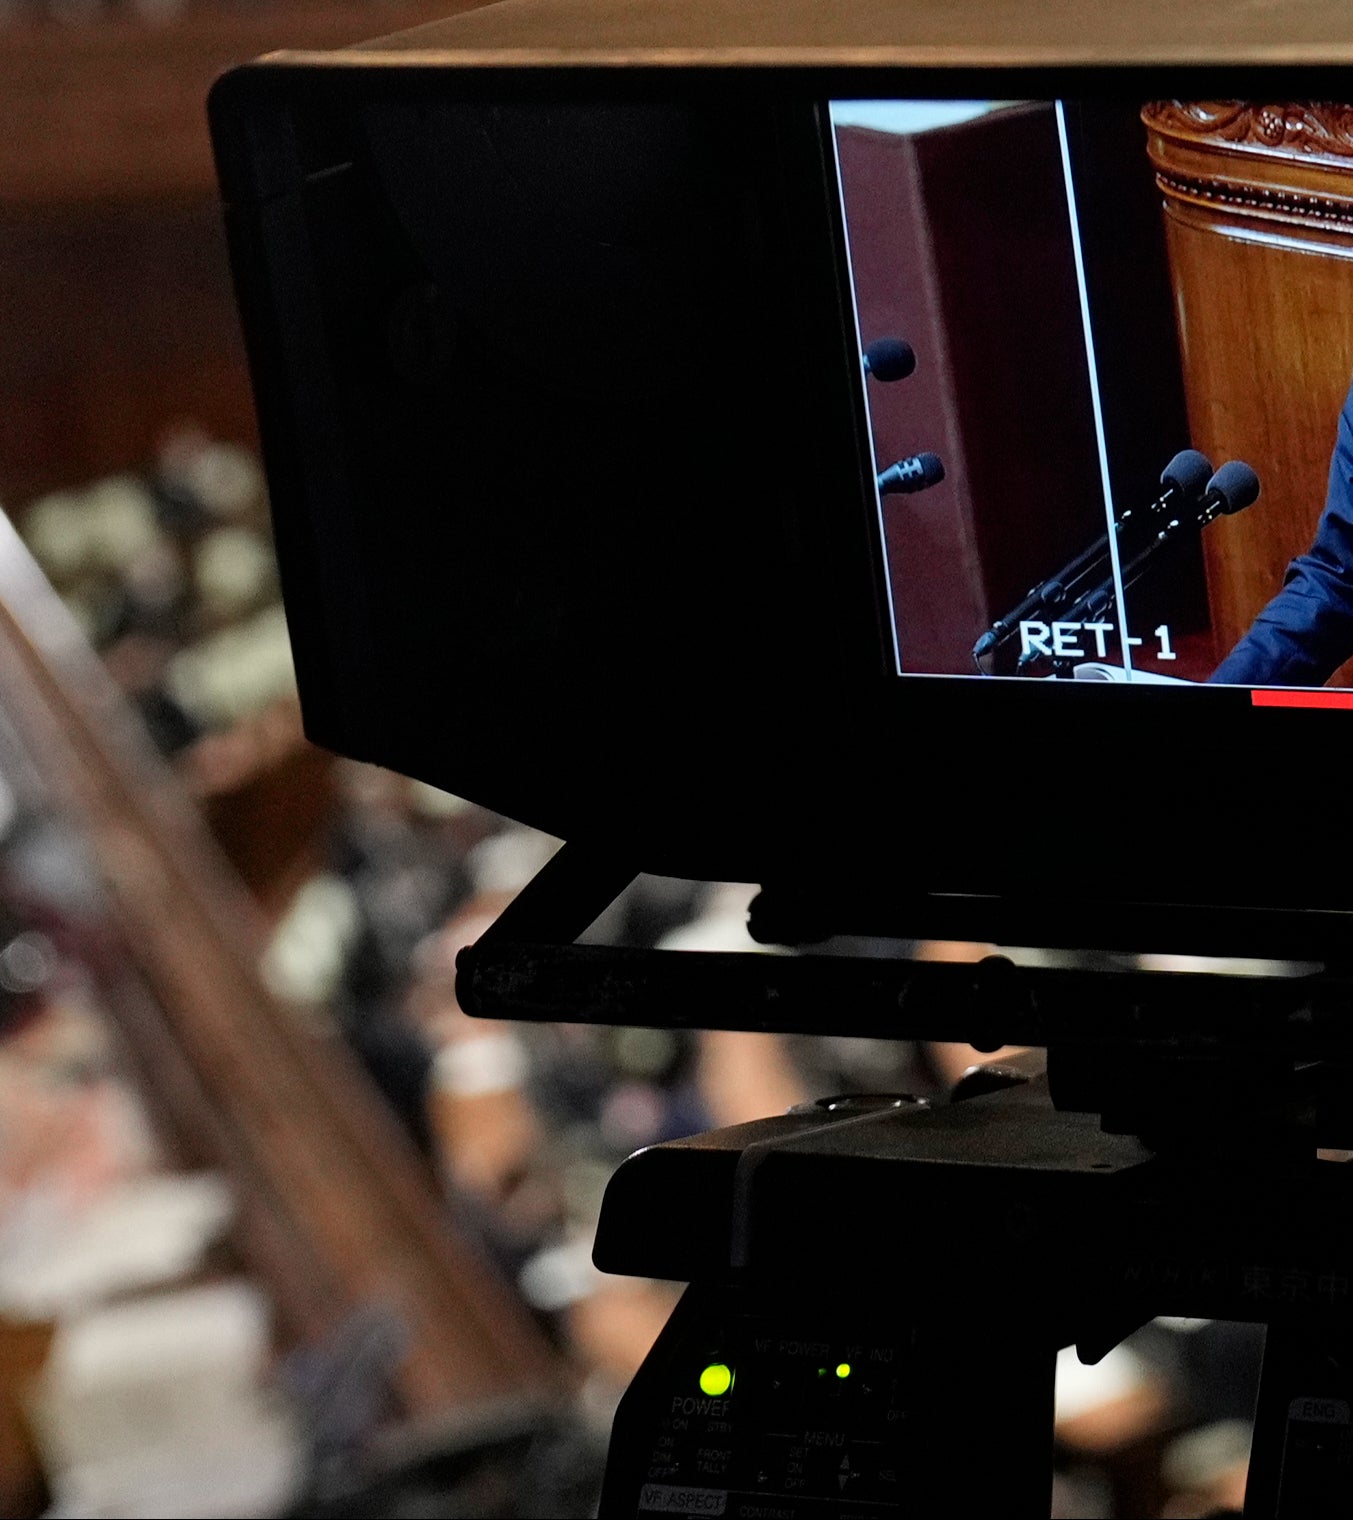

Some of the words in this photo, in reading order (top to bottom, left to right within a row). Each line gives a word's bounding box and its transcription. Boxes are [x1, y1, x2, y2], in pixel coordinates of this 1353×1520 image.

[1019, 621, 1176, 660] RET-1
[754, 1338, 772, 1353] VF
[779, 1339, 832, 1359] POWER
[845, 1345, 864, 1360] VF
[1302, 1401, 1336, 1420] ENG
[803, 1430, 847, 1447] MENU
[696, 1447, 733, 1461] FRONT
[696, 1460, 727, 1474] TALLY
[645, 1490, 662, 1505] VF
[667, 1492, 723, 1510] ASPECT
